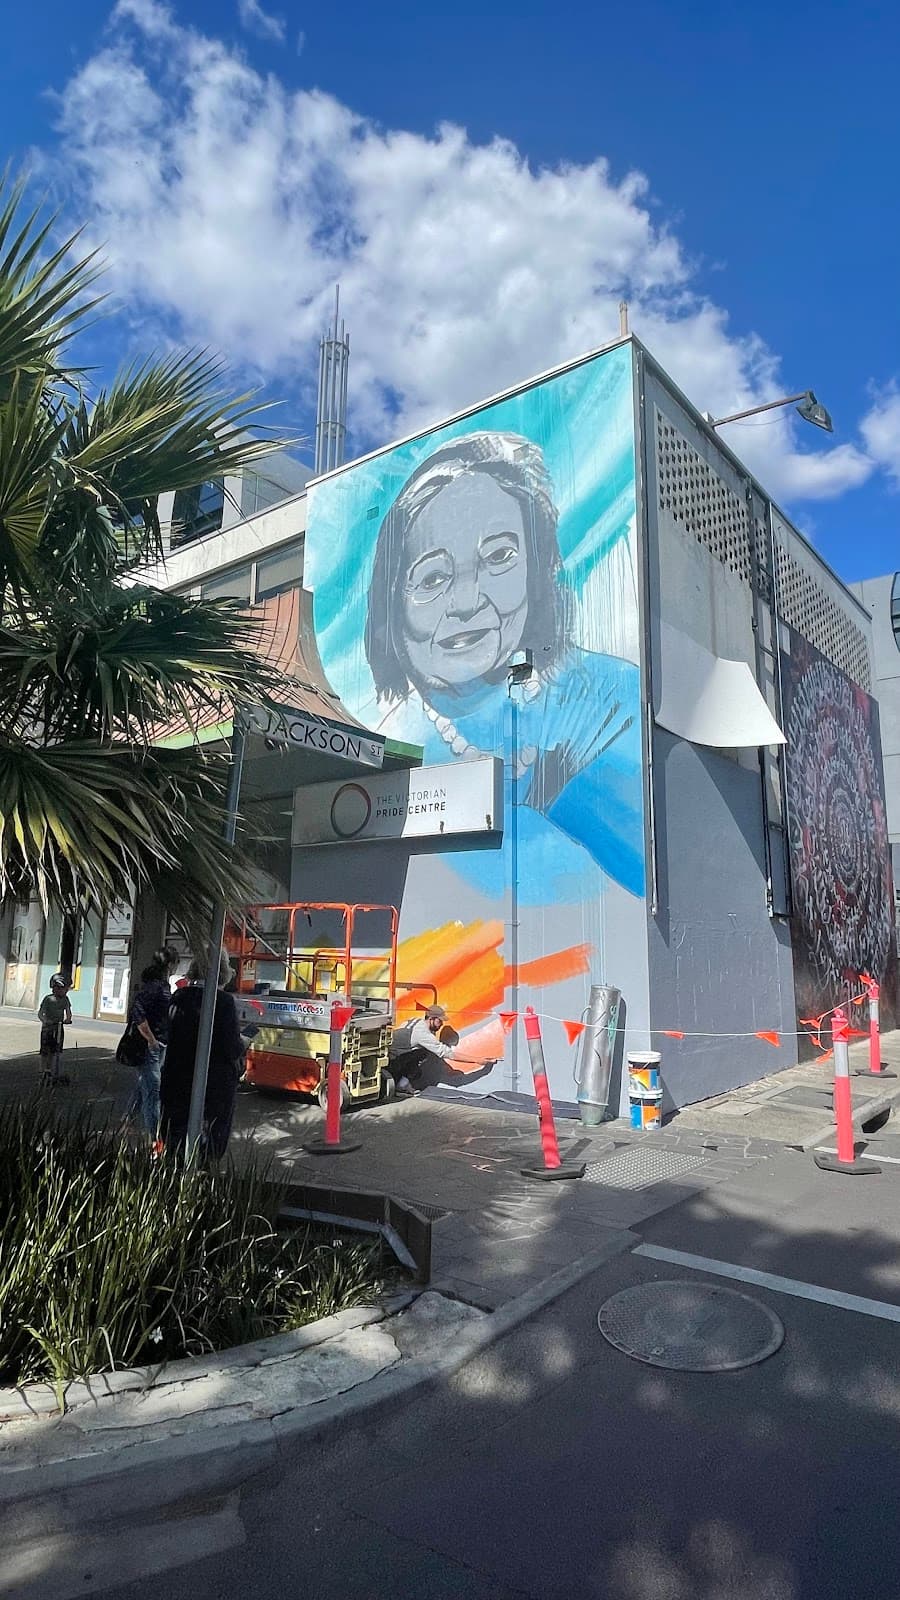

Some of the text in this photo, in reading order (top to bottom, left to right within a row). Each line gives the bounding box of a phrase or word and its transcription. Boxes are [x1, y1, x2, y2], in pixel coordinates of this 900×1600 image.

[262, 711, 382, 758] JACKSON ST
[376, 788, 447, 805] THE VICTORIAN
[375, 801, 446, 818] PRIDE CENTRE
